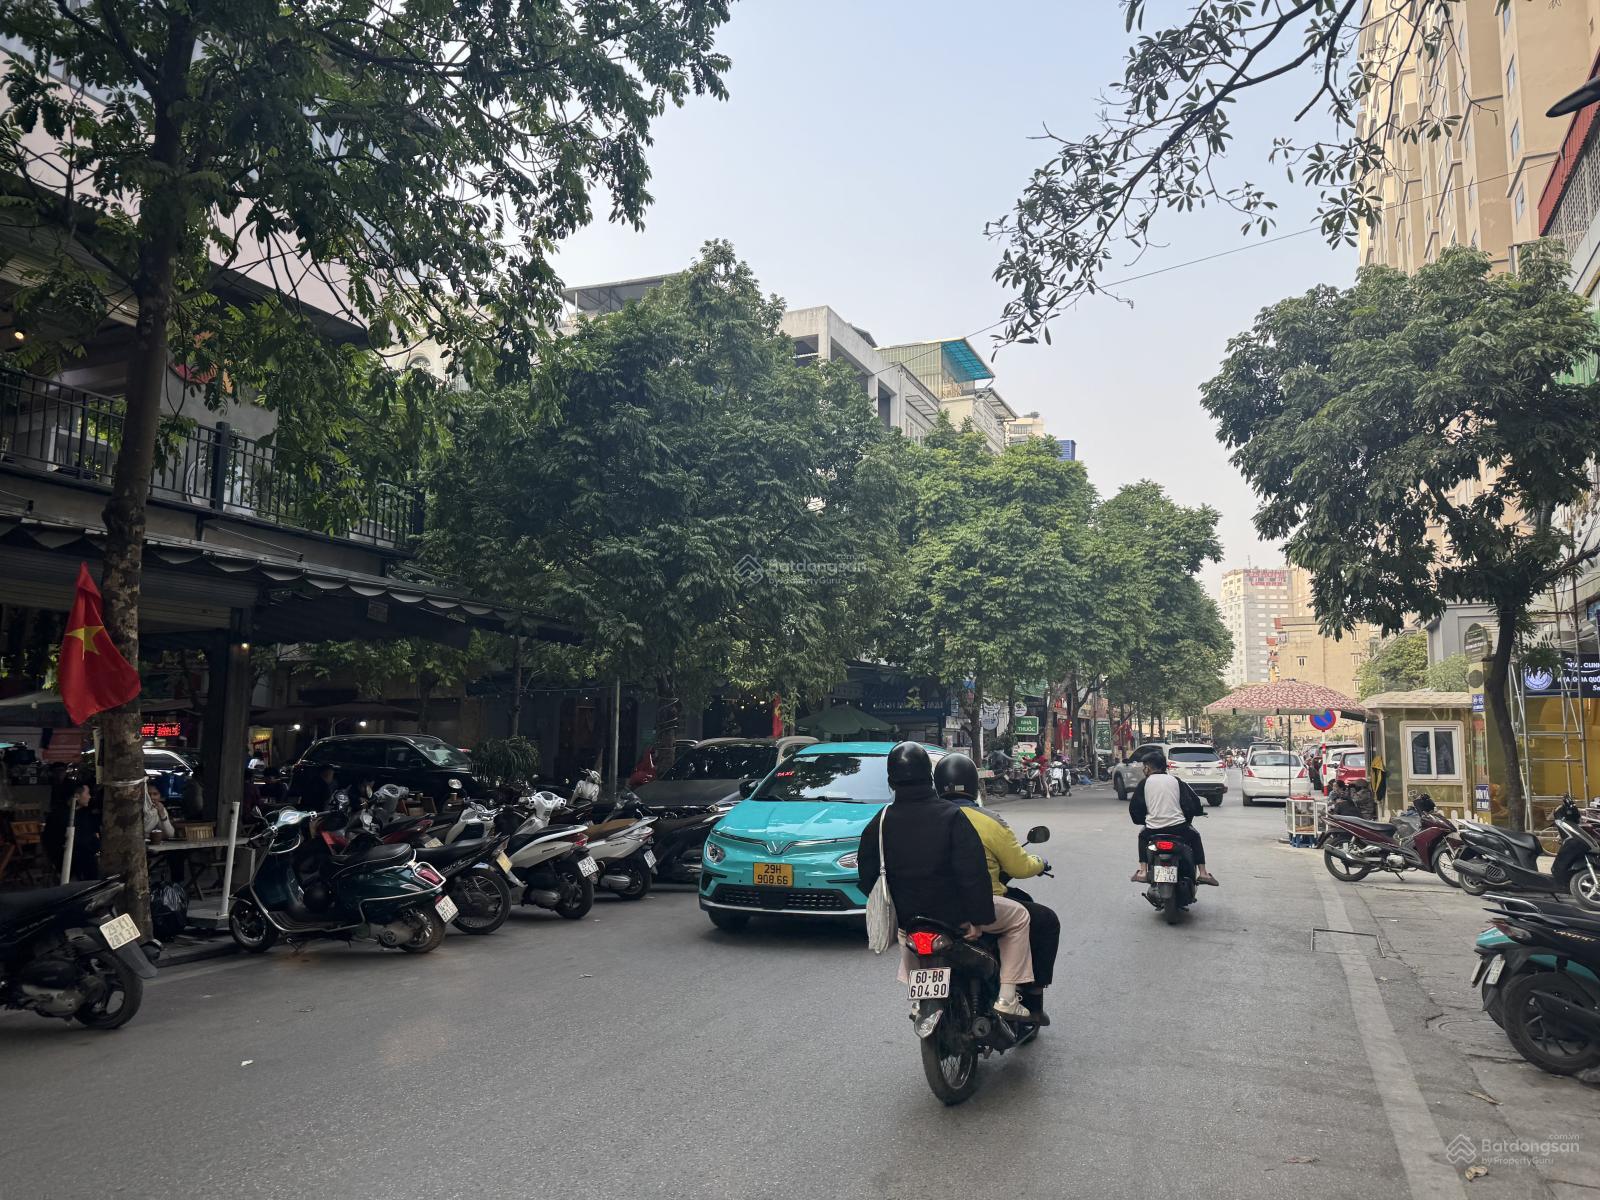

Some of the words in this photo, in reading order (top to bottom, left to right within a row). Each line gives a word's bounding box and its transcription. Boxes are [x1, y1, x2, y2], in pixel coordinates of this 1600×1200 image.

[764, 865, 782, 874] 29H
[757, 875, 788, 885] 908.66
[911, 983, 947, 998] 604.90
